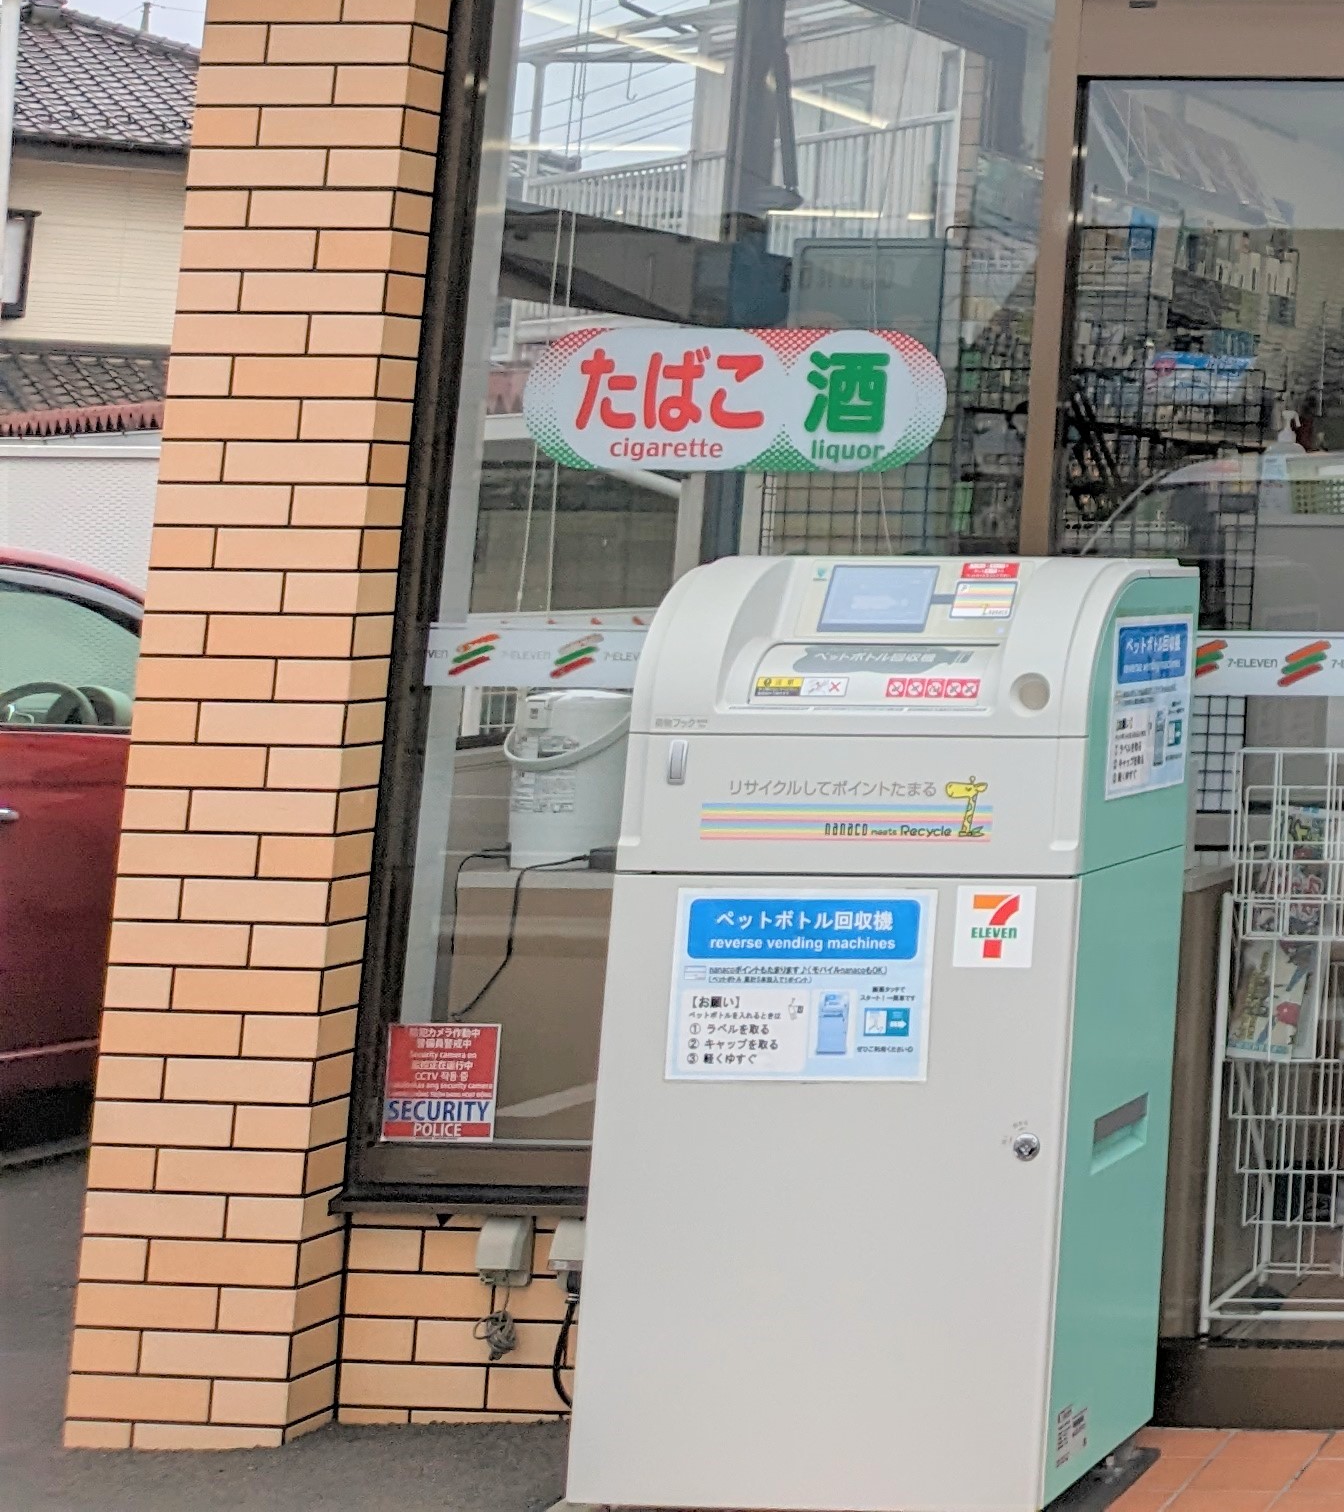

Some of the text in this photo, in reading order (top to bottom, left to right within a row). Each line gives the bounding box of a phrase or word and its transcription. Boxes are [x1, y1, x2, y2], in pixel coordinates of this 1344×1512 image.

[574, 345, 891, 434] たばこ 酒
[609, 437, 886, 463] cigarette liquor
[729, 779, 937, 797] リサイクルしてポイントたまる
[900, 824, 952, 839] Recycle
[715, 909, 895, 931] ペットボトル回収機
[710, 936, 896, 952] reverse vending machines
[387, 1100, 490, 1122] SECURITY
[413, 1123, 462, 1137] POLICE
